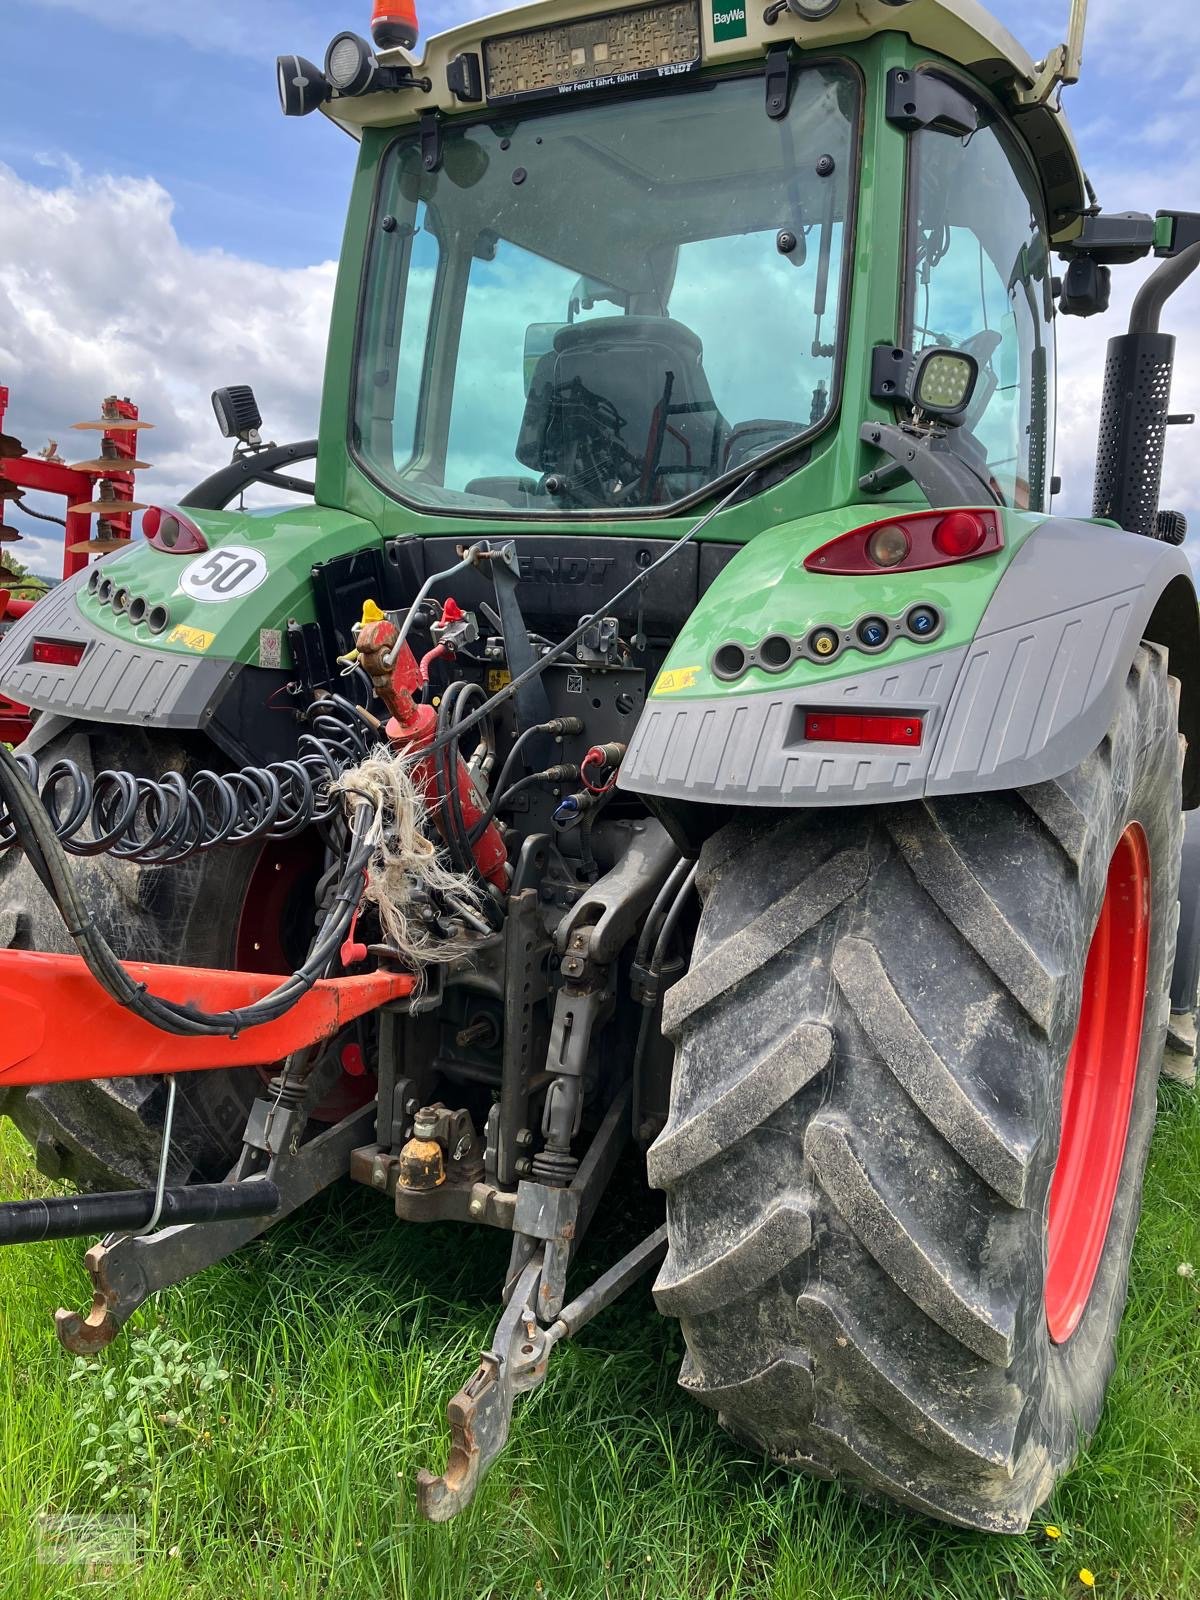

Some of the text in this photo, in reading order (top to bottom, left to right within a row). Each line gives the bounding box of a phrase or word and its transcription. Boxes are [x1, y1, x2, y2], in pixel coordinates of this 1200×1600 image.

[713, 8, 745, 25] BayWa
[657, 61, 694, 77] FENDT
[558, 83, 573, 94] Wer
[573, 79, 595, 92] Fendt
[190, 550, 258, 593] 50
[516, 556, 616, 586] ENDT
